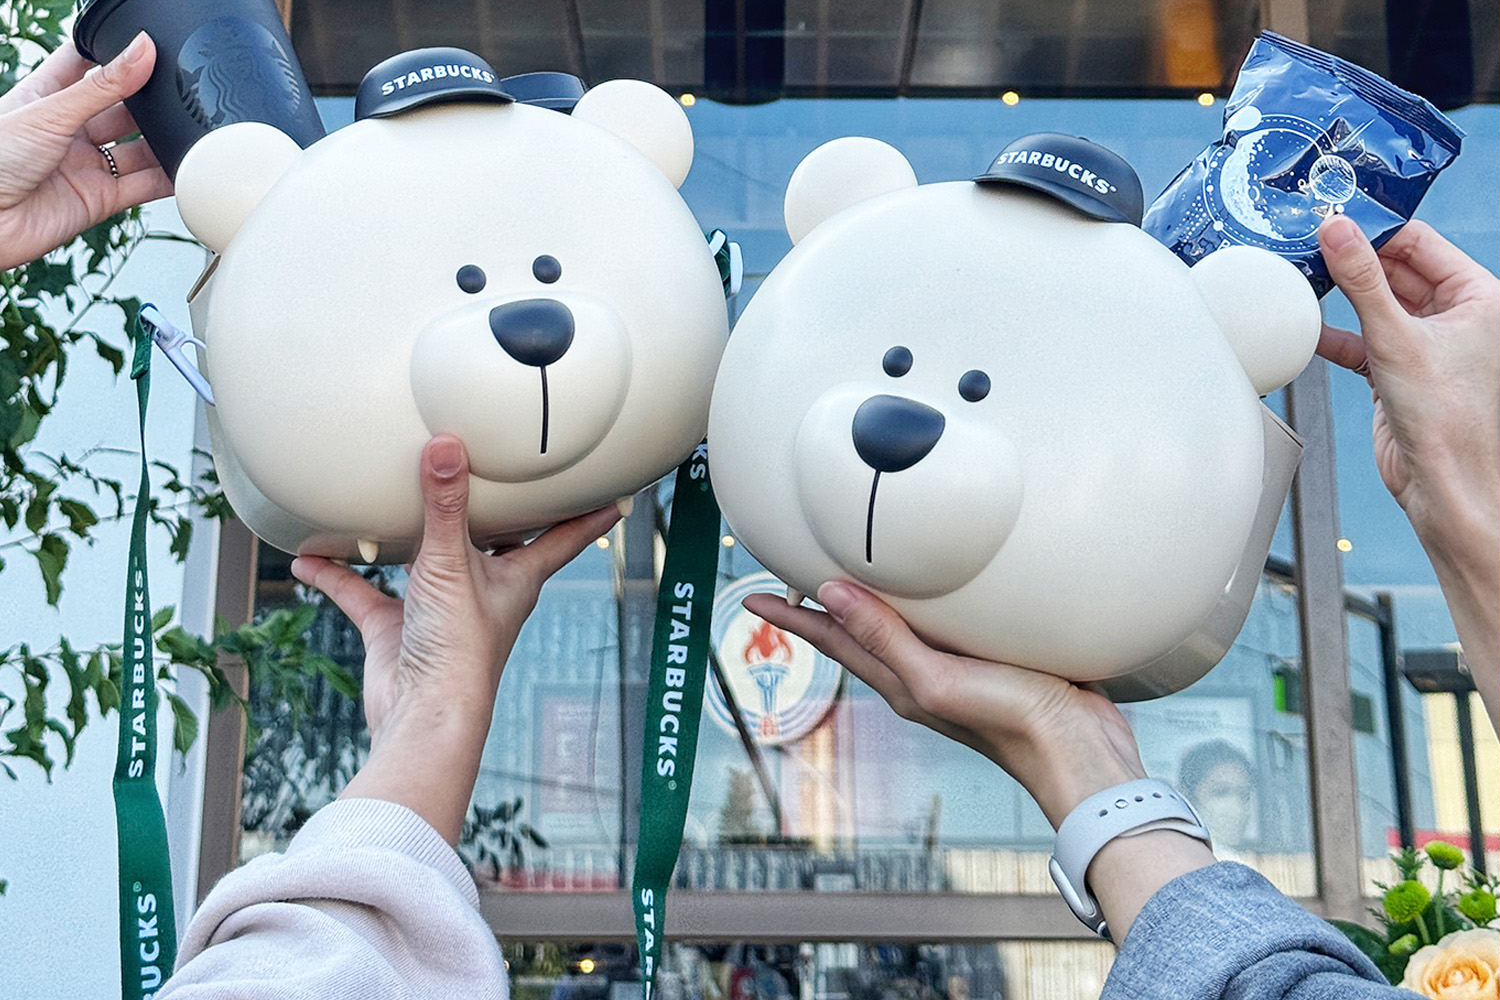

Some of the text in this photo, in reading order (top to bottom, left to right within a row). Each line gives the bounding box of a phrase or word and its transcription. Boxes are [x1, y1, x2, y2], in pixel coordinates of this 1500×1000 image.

[381, 64, 493, 96] STARBUCKS
[997, 151, 1112, 194] STARBUCKS
[128, 569, 147, 779] STARBUCKS
[656, 581, 695, 777] STARBUCKS
